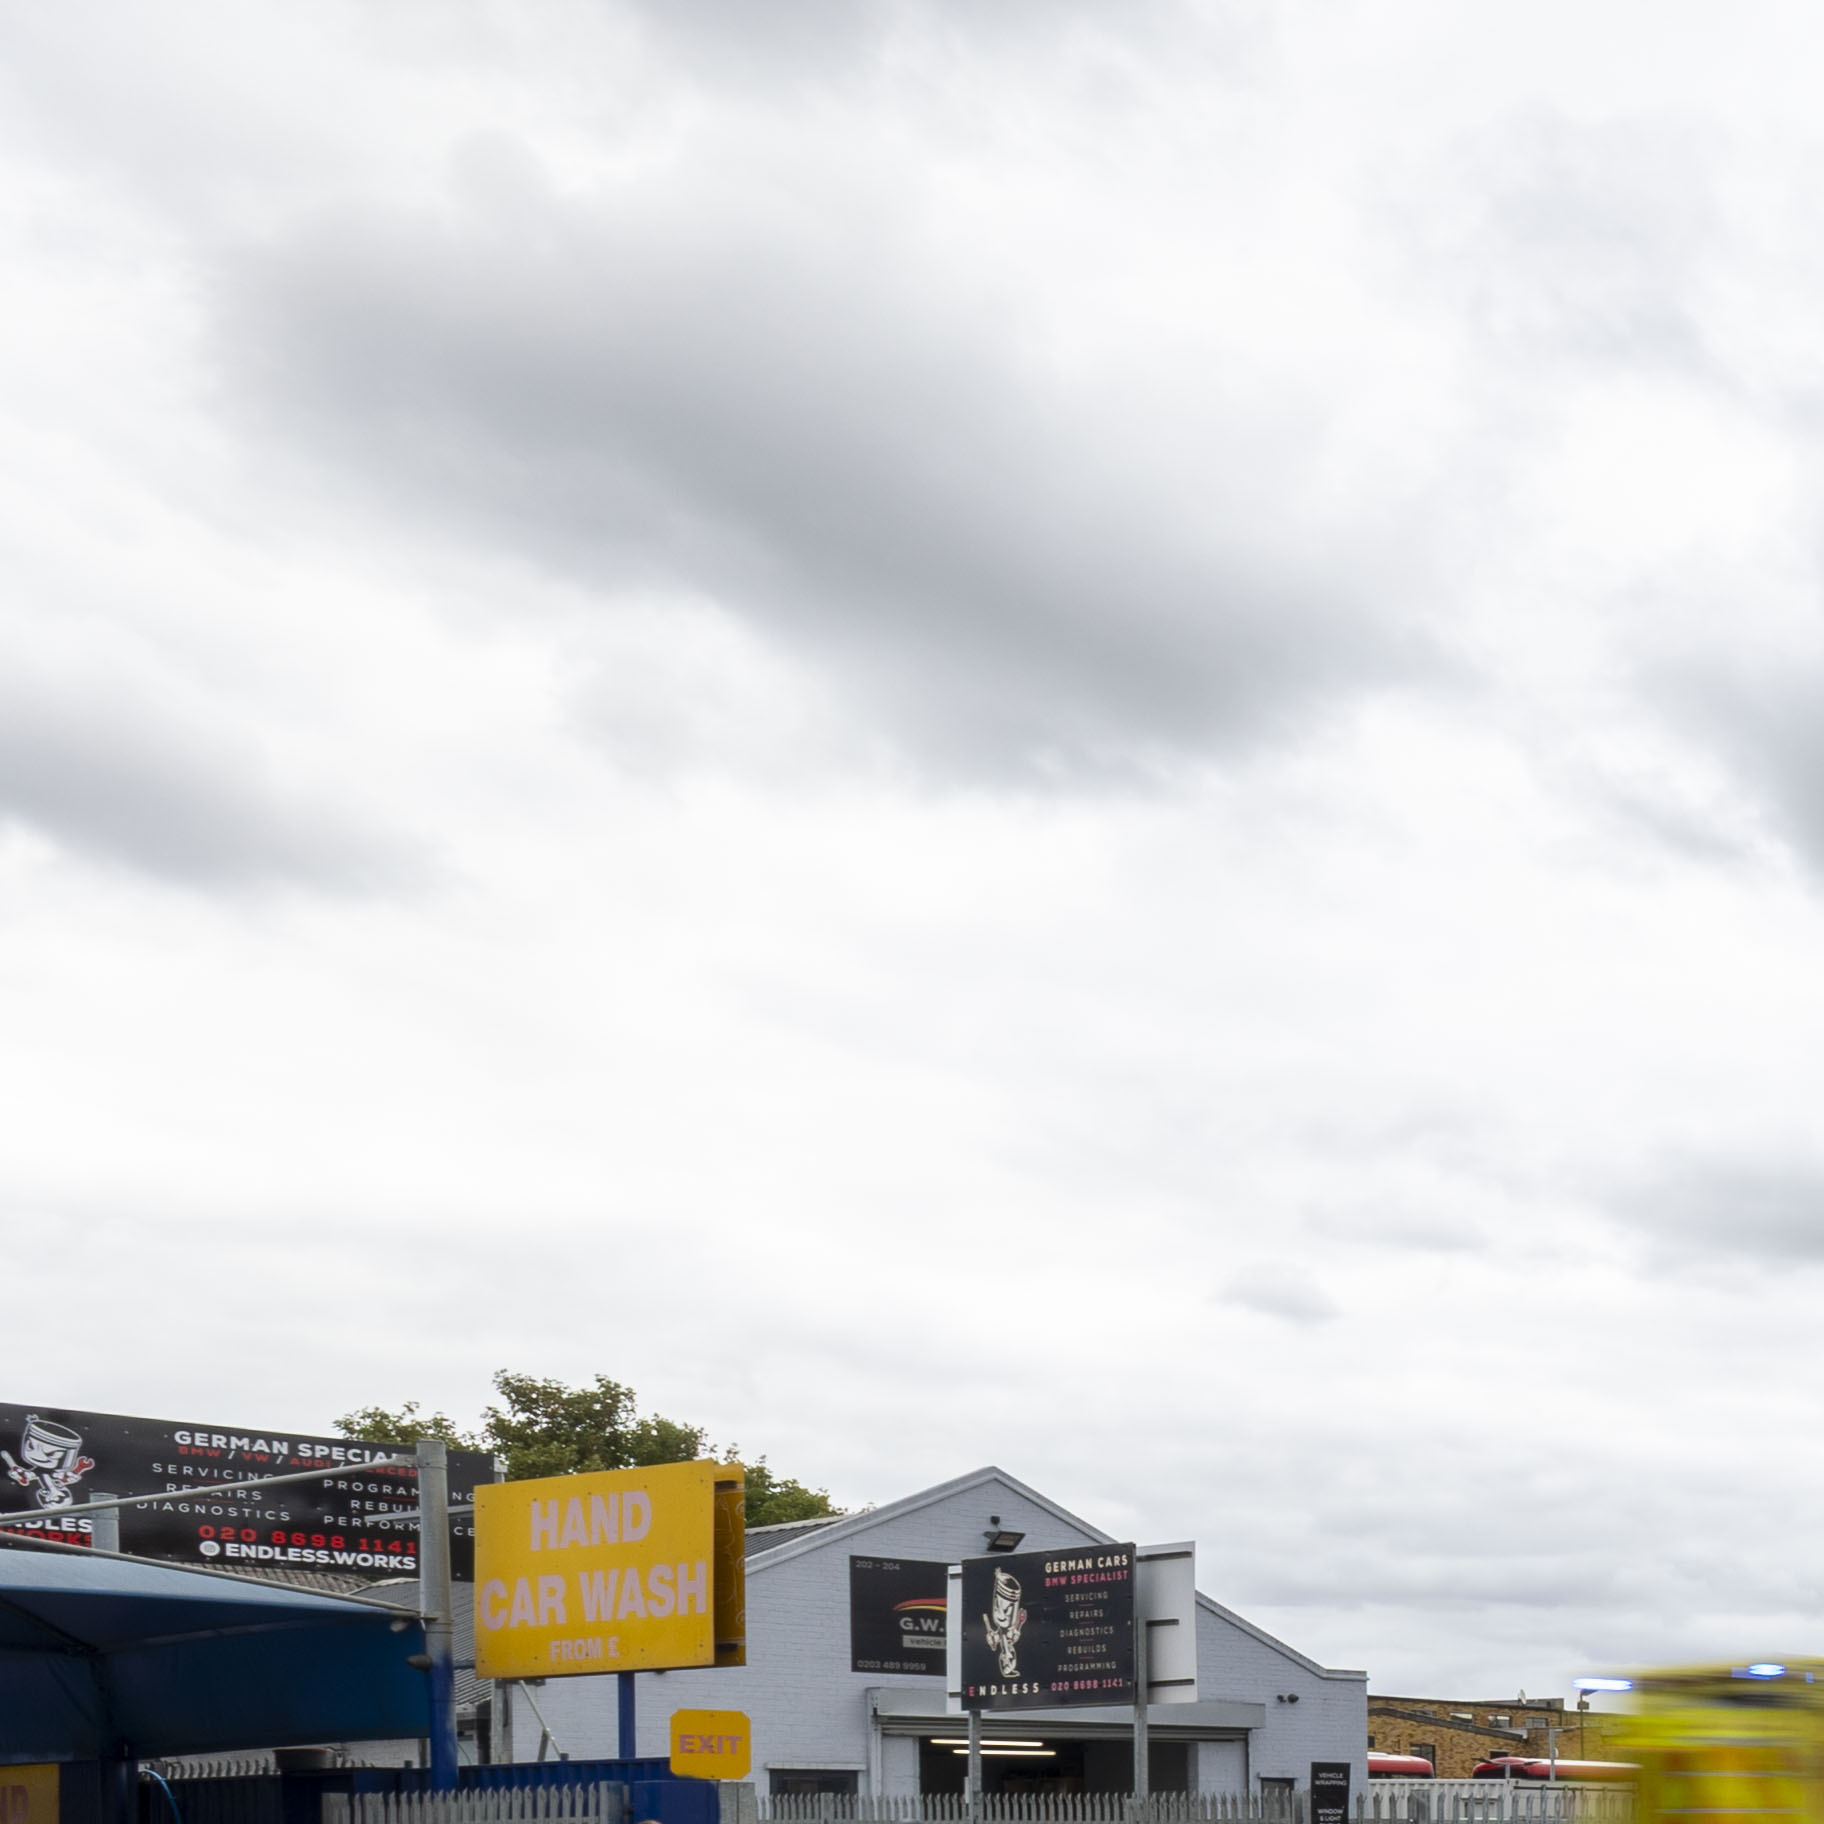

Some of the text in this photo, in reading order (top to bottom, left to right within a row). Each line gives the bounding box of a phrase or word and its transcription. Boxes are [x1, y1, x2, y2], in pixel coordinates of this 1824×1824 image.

[174, 1431, 397, 1463] GERMAN SPECIA
[178, 1446, 331, 1469] BMW VW AUDI
[530, 1490, 651, 1552] HAND
[199, 1525, 417, 1554] 020 8698 1141
[225, 1543, 417, 1570] ENDLESS.WORKS
[1045, 1554, 1128, 1574] GERMAN CARS
[1044, 1570, 1129, 1588] BMW SPECIALIST
[479, 1561, 707, 1631] CAR WASH
[1065, 1591, 1109, 1603] SERVICING
[1069, 1609, 1104, 1620] REPAIRS
[1060, 1626, 1114, 1638] DIAGNOSTICS
[551, 1636, 620, 1662] FROM £
[1067, 1644, 1107, 1655] REBUILDS
[1058, 1661, 1117, 1673] PROGRAMMING
[968, 1683, 1040, 1697] ENDLESS
[1051, 1678, 1123, 1692] 020 8698 1141
[679, 1734, 742, 1755] EXIT
